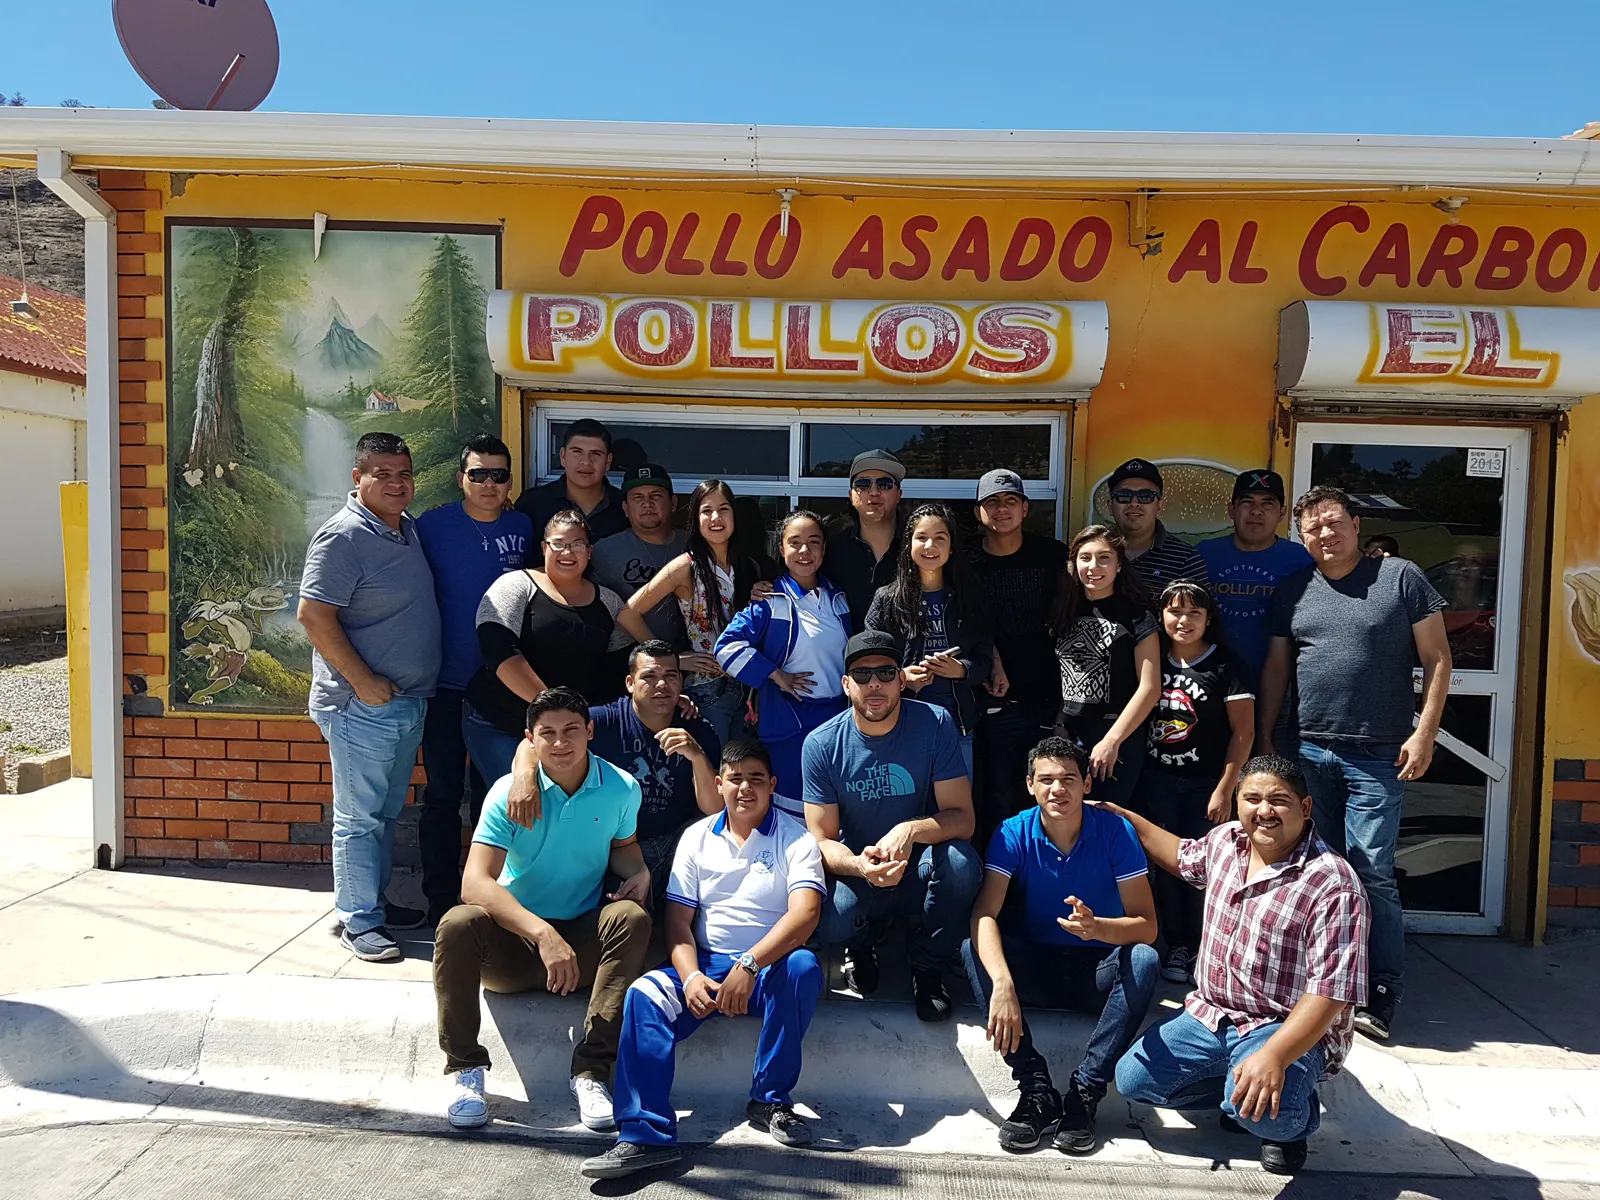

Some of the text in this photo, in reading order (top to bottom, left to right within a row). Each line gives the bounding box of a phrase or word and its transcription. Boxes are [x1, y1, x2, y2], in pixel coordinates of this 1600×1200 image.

[558, 195, 1600, 297] POLLO ASADO AL CARBO
[527, 296, 1058, 375] POLLOS
[1379, 308, 1543, 380] EL
[1470, 457, 1502, 471] 2013
[495, 534, 525, 554] NYC
[1218, 564, 1276, 582] SOUTHERN
[864, 764, 888, 779] THE
[845, 775, 890, 793] NORTH
[860, 785, 891, 802] FACE
